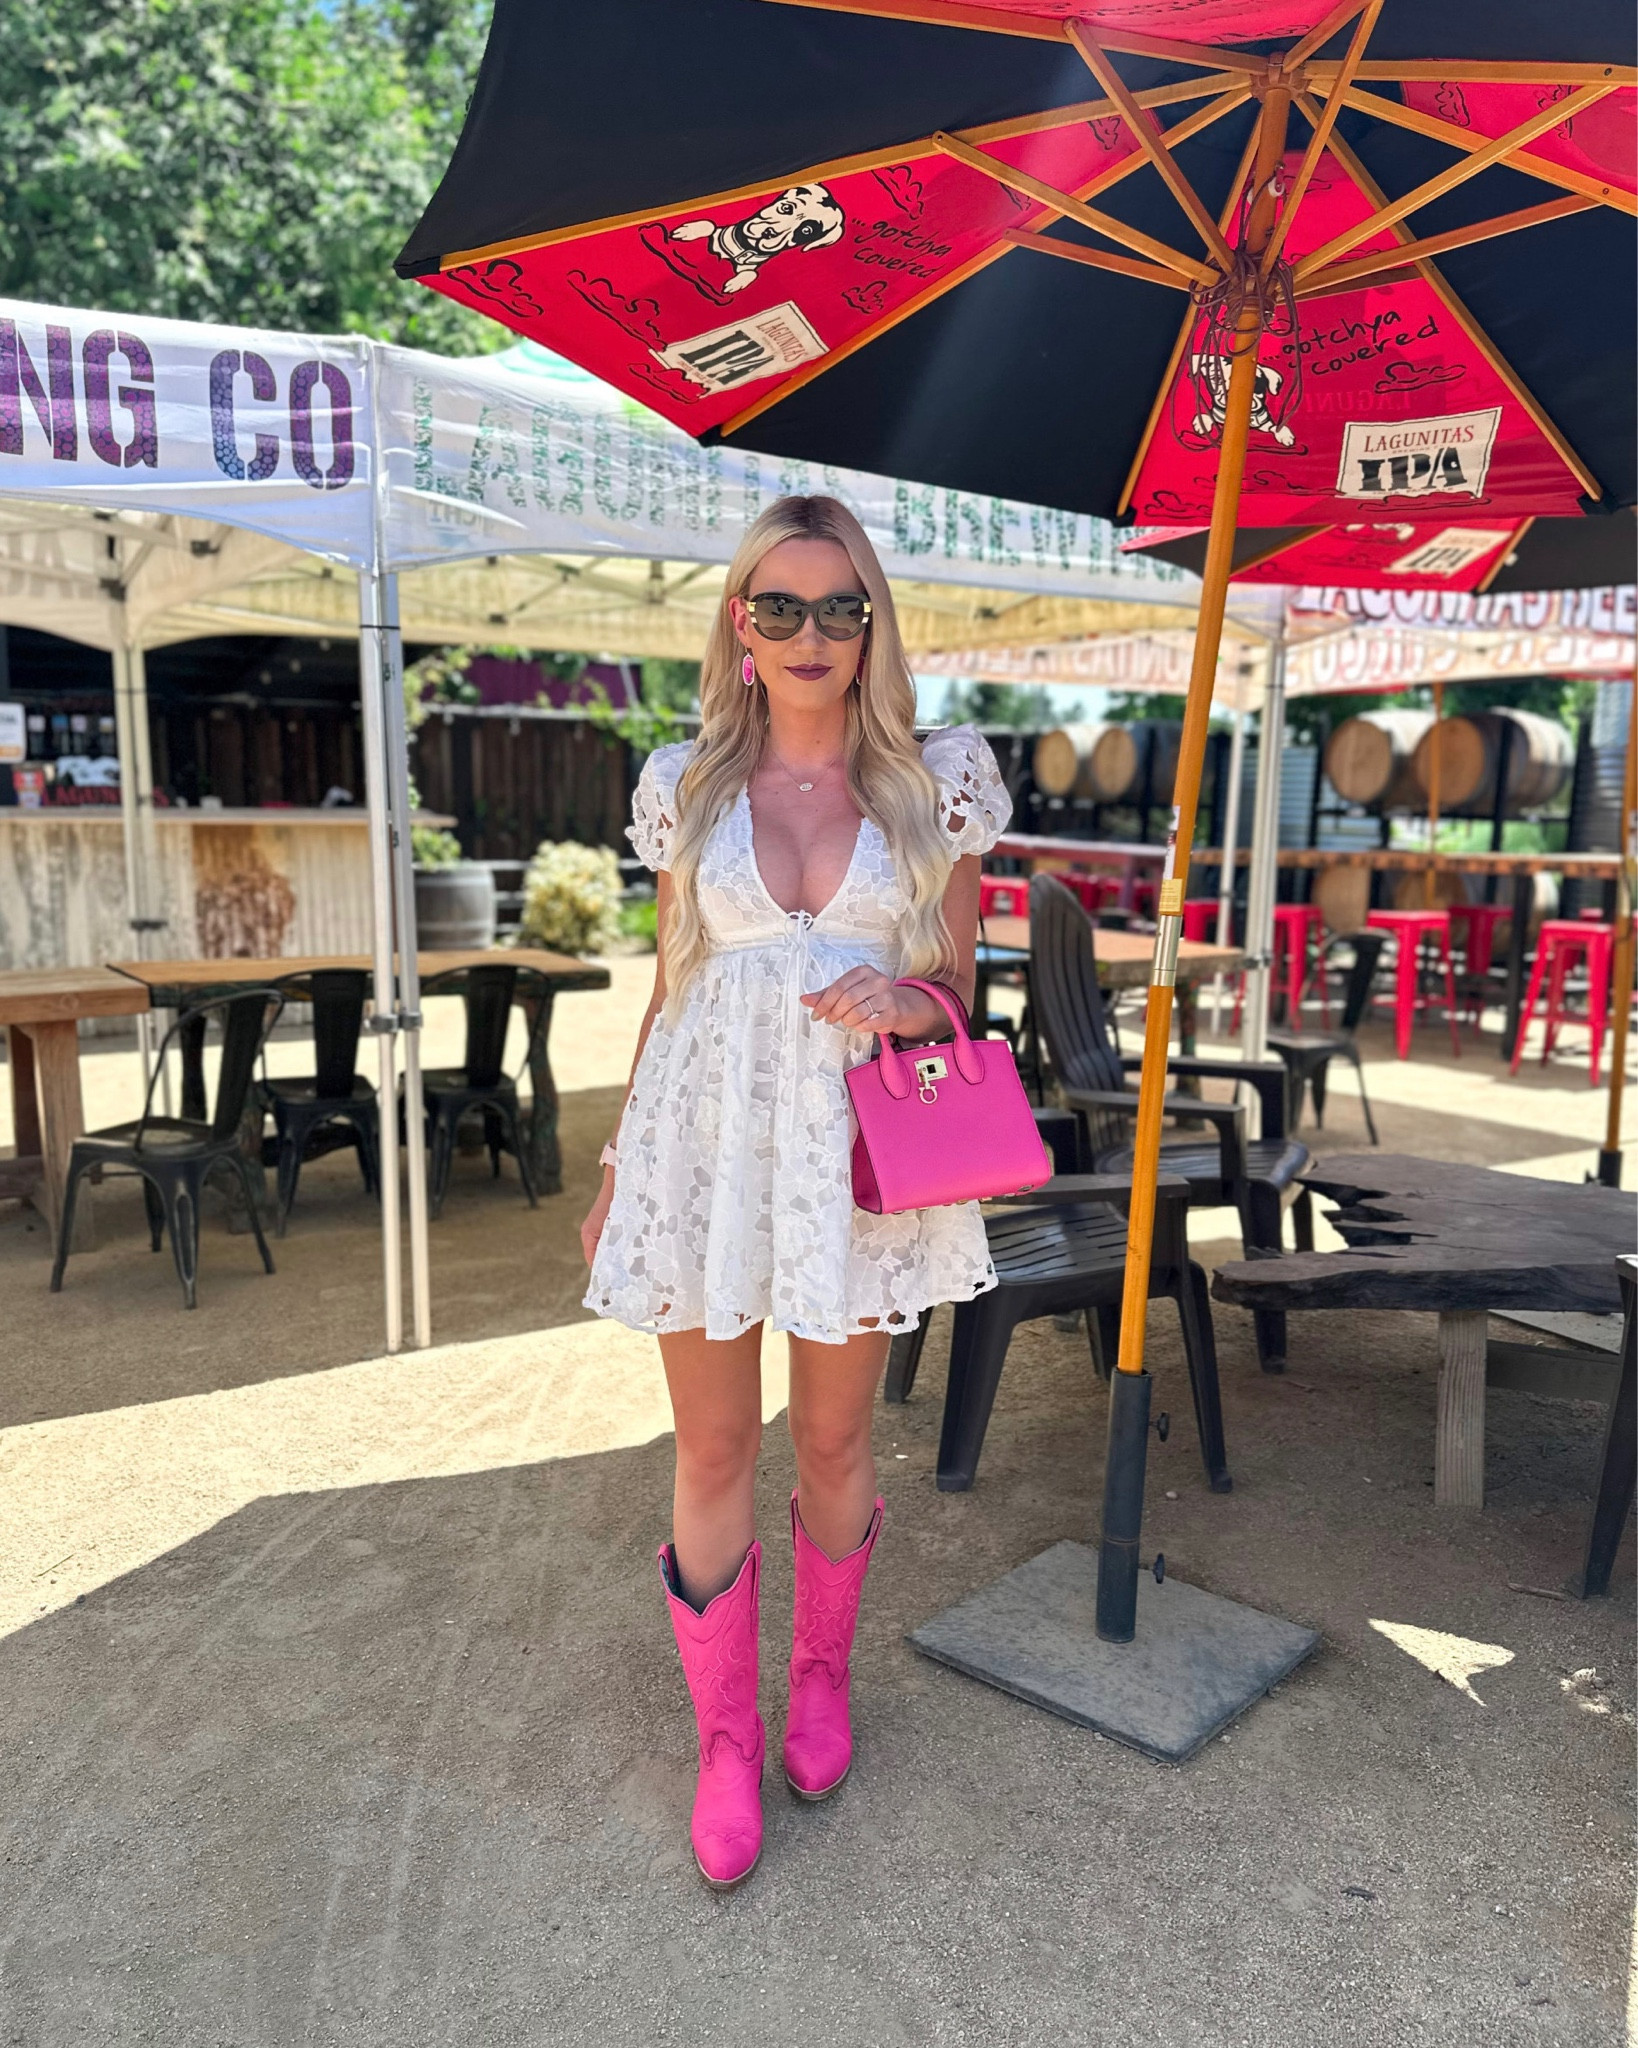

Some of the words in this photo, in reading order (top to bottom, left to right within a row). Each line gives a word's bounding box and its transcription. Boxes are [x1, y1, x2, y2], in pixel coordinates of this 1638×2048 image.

[854, 247, 946, 278] covered
[678, 330, 775, 385] IPA
[756, 316, 809, 363] LAGUNITAS
[1311, 315, 1440, 375] covered
[209, 348, 355, 490] CO
[1364, 424, 1475, 453] LAGUNITAS
[1357, 446, 1468, 491] IPA
